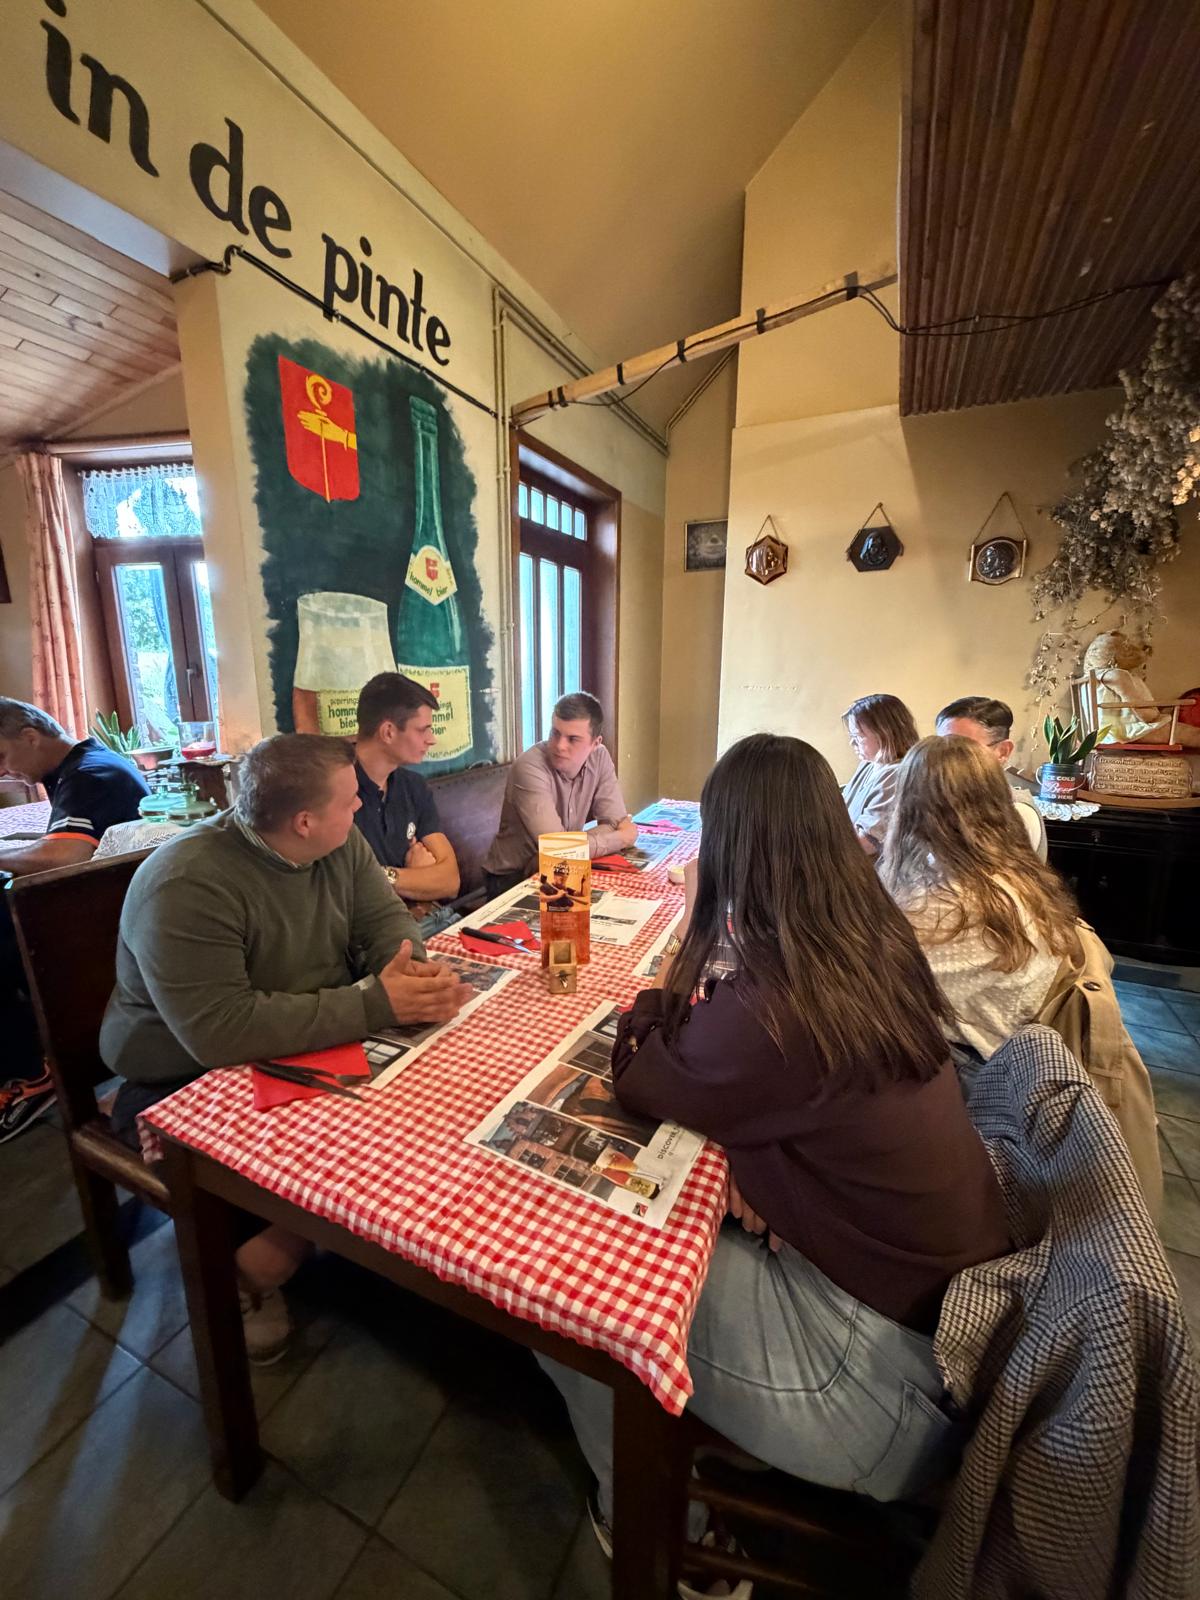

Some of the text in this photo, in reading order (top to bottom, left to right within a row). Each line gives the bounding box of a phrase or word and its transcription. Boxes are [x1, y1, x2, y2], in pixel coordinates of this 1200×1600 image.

[39, 0, 451, 366] in de pinte
[328, 704, 357, 718] homm
